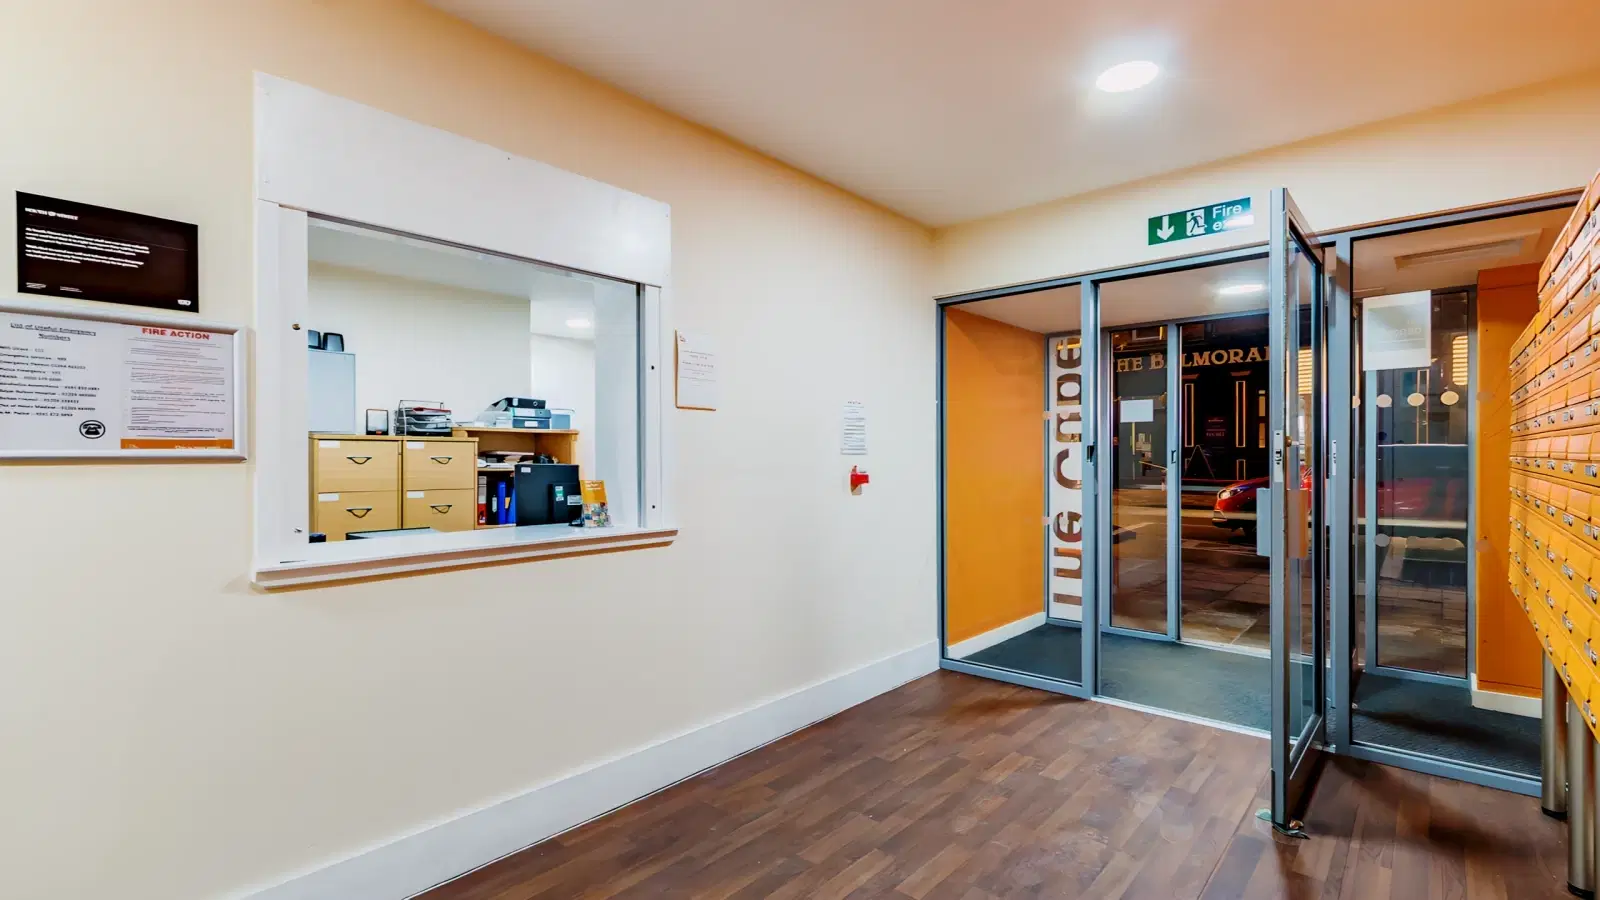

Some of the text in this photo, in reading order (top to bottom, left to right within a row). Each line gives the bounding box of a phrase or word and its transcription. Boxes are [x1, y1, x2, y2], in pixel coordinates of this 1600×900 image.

[1212, 204, 1242, 219] Fire
[142, 327, 210, 340] FIRE ACTION
[1117, 345, 1269, 373] HE BLMORA
